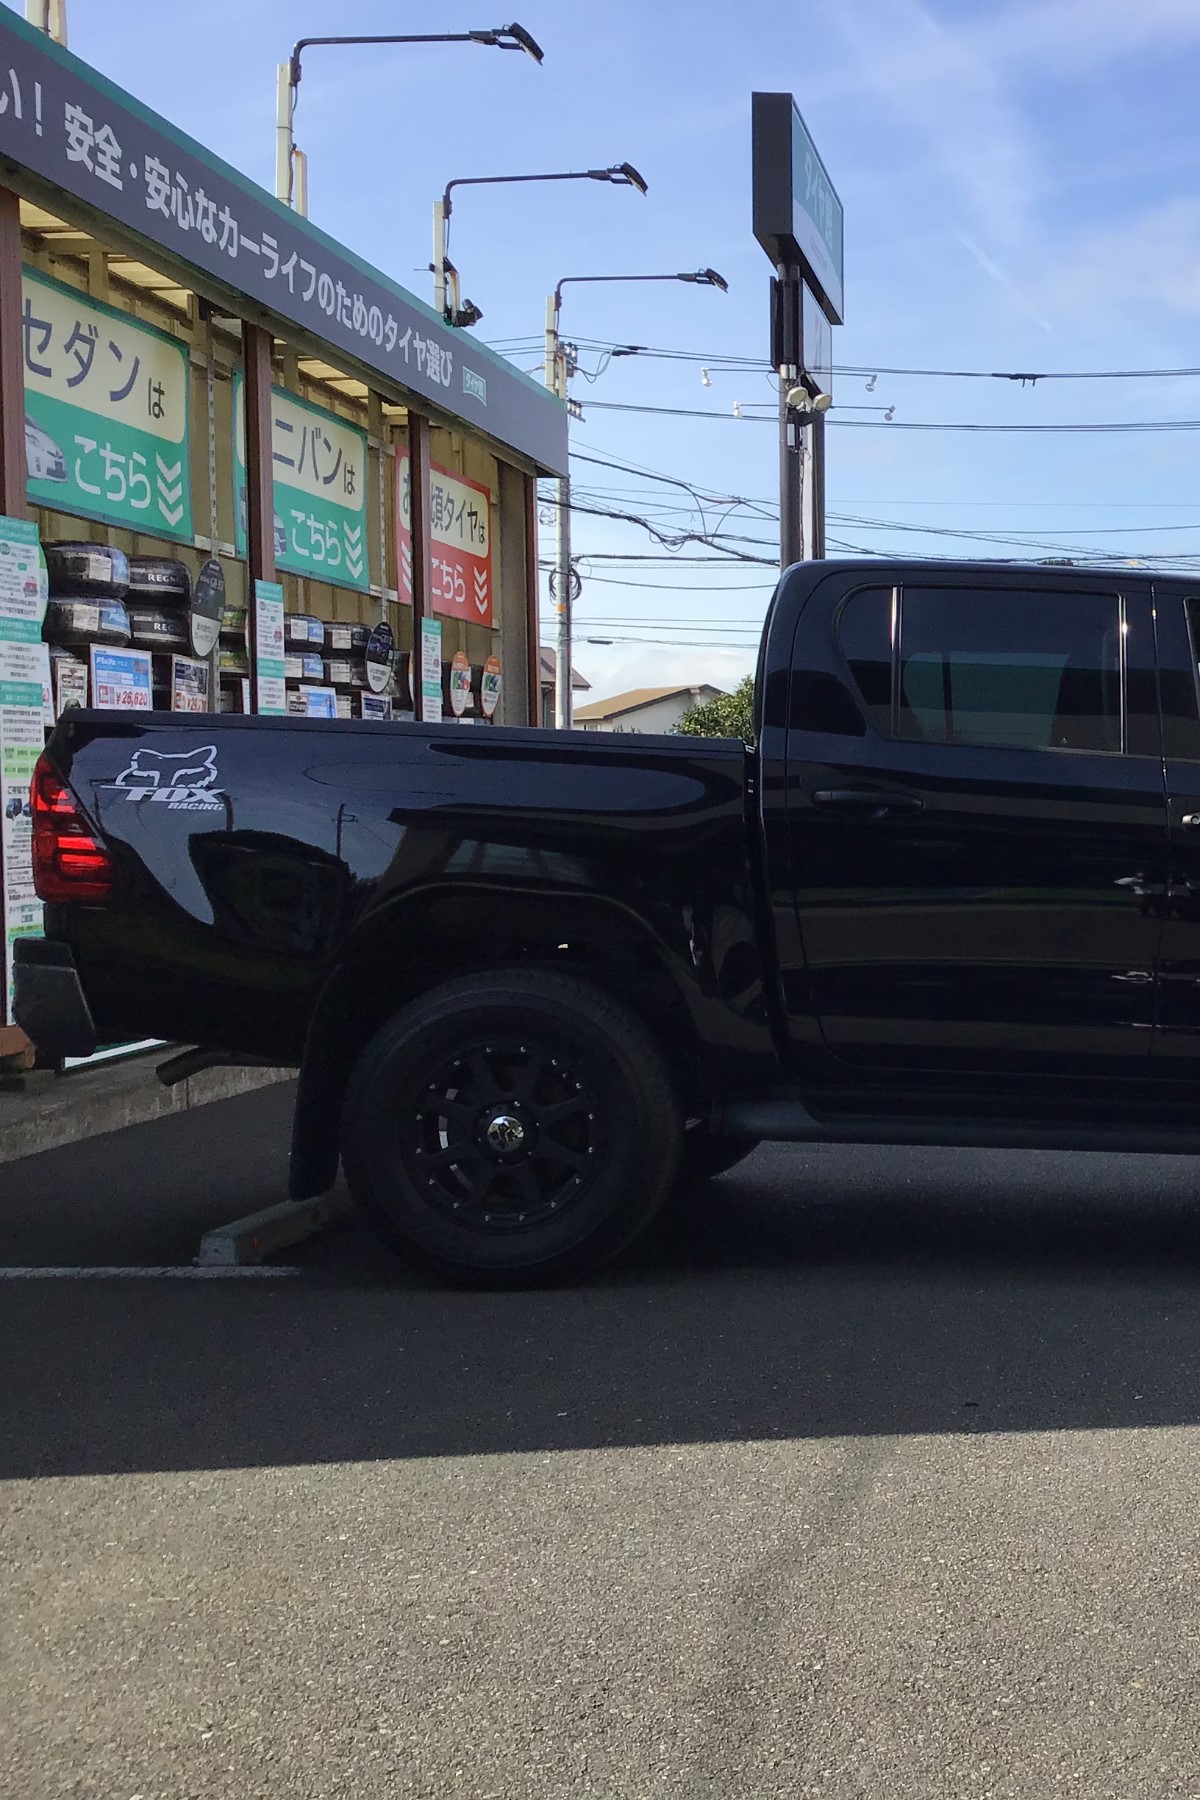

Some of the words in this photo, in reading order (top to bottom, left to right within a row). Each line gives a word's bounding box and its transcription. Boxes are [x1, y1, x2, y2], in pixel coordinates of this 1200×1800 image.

[74, 433, 152, 509] こちら
[290, 509, 342, 566] こちら
[100, 785, 226, 803] FOX
[167, 802, 225, 811] RACING
